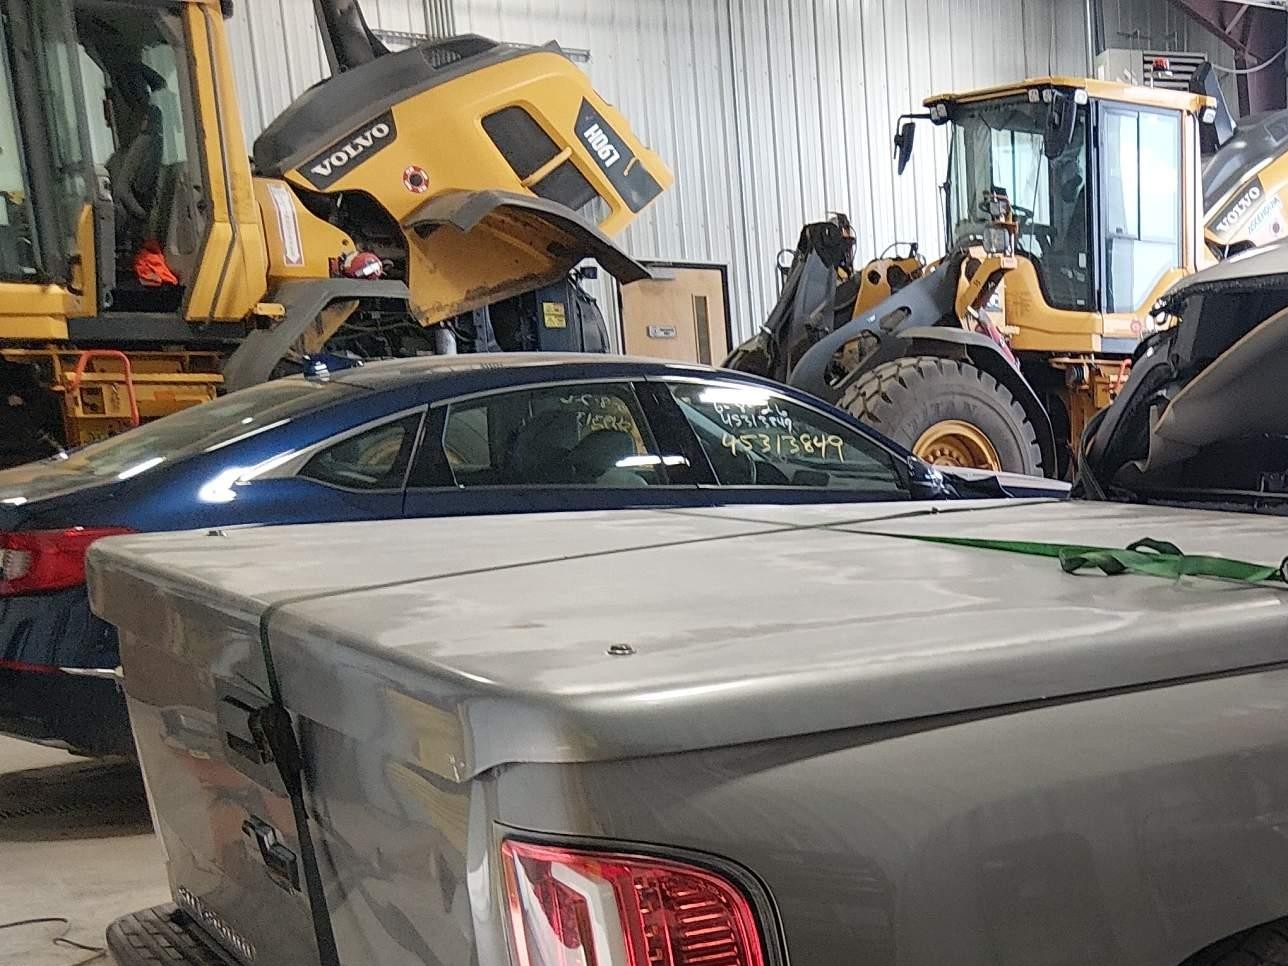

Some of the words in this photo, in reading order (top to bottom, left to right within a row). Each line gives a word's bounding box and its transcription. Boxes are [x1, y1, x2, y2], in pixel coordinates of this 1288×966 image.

[311, 122, 391, 178] VOLVO
[1216, 187, 1261, 232] VOLVO
[721, 432, 845, 463] 45313849
